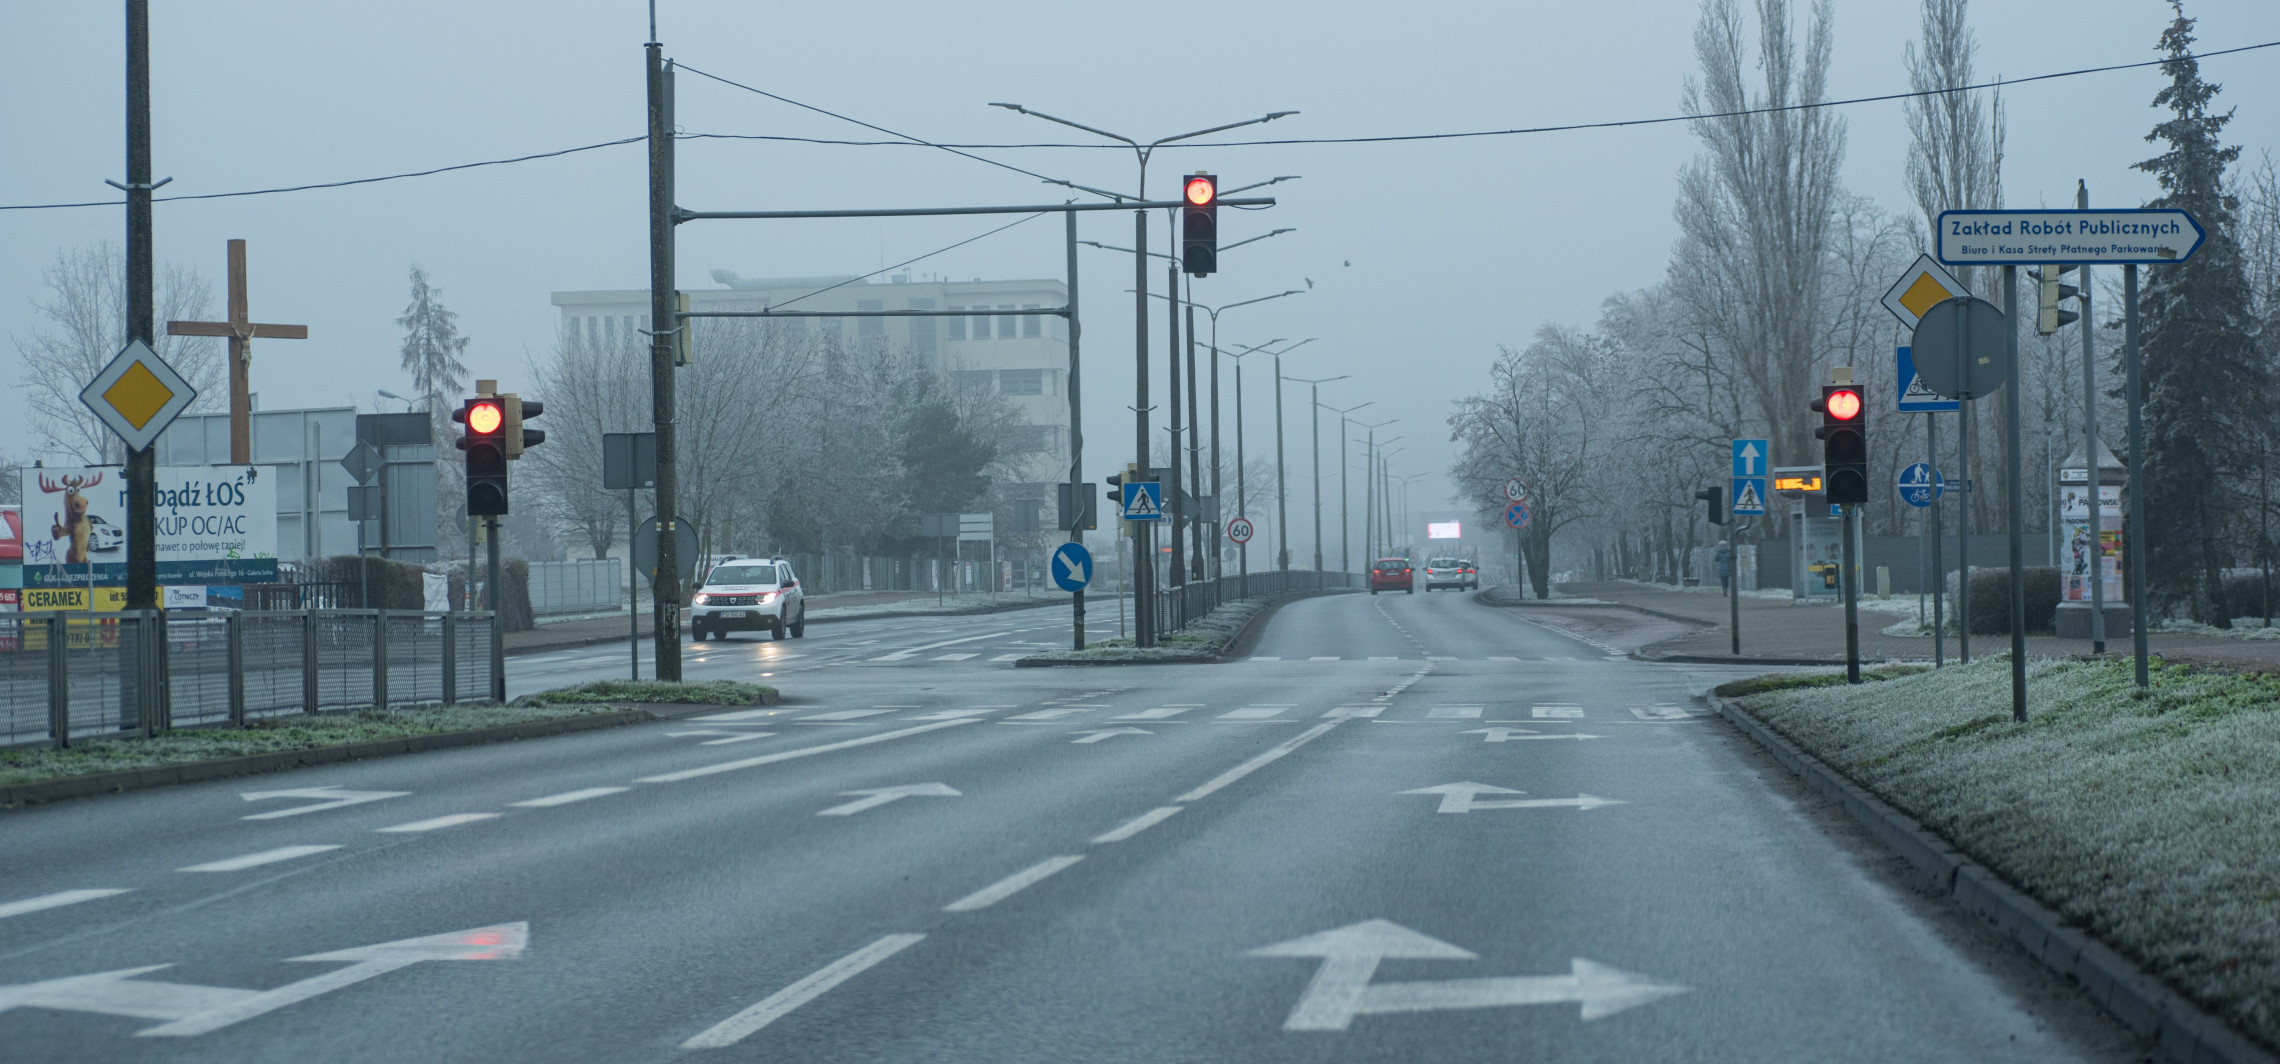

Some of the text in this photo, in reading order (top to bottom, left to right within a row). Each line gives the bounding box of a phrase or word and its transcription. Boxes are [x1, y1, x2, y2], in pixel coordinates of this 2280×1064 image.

[1952, 219, 2181, 238] Zakład Robót Publicznych
[1962, 244, 2170, 256] Biuro i Kasa Strefy Płatnego Parkowan
[1510, 485, 1526, 496] 60
[154, 481, 201, 516] bądź
[192, 515, 246, 537] OC/AC
[1233, 525, 1249, 537] 60
[155, 540, 246, 554] nawet o połowę taniej!
[196, 570, 214, 579] Wojska
[28, 591, 82, 607] CERAMEX
